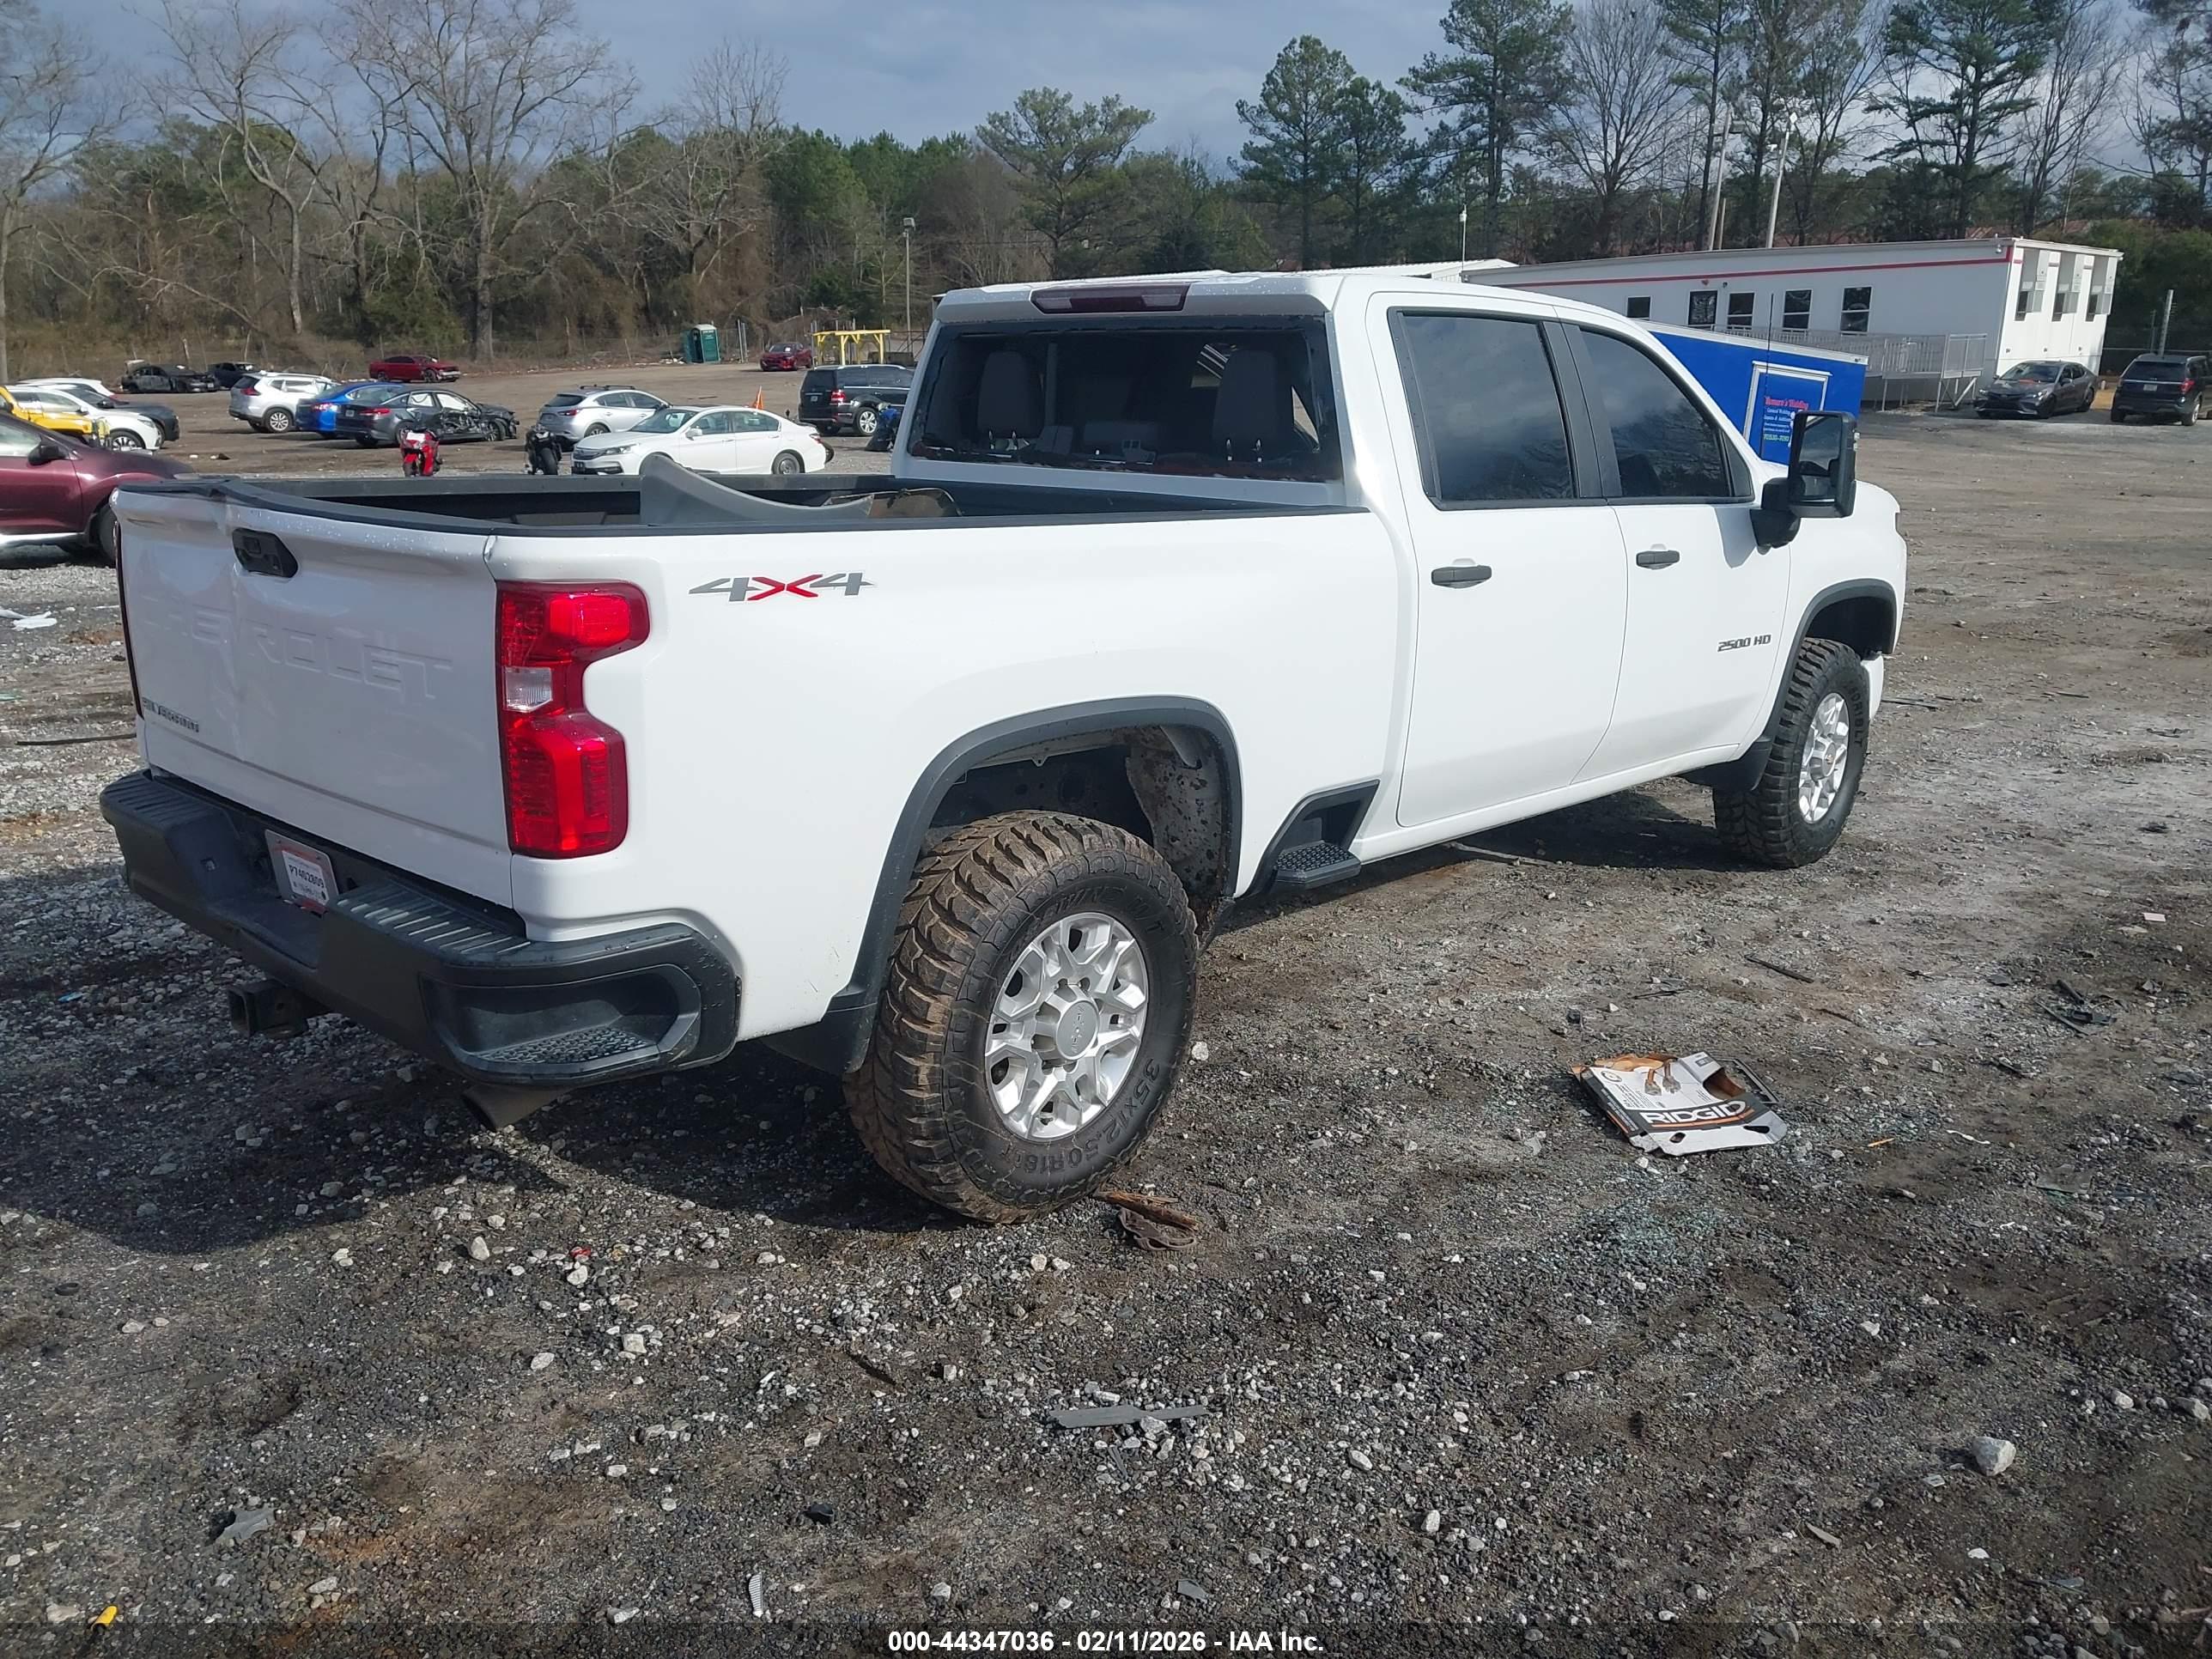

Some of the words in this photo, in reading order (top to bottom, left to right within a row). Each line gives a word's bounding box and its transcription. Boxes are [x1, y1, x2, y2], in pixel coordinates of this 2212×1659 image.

[688, 572, 874, 602] 4X4
[140, 593, 453, 702] EROLET
[1717, 637, 1752, 652] 2500
[1753, 635, 1771, 646] HD
[1639, 1101, 1746, 1124] RIDGID
